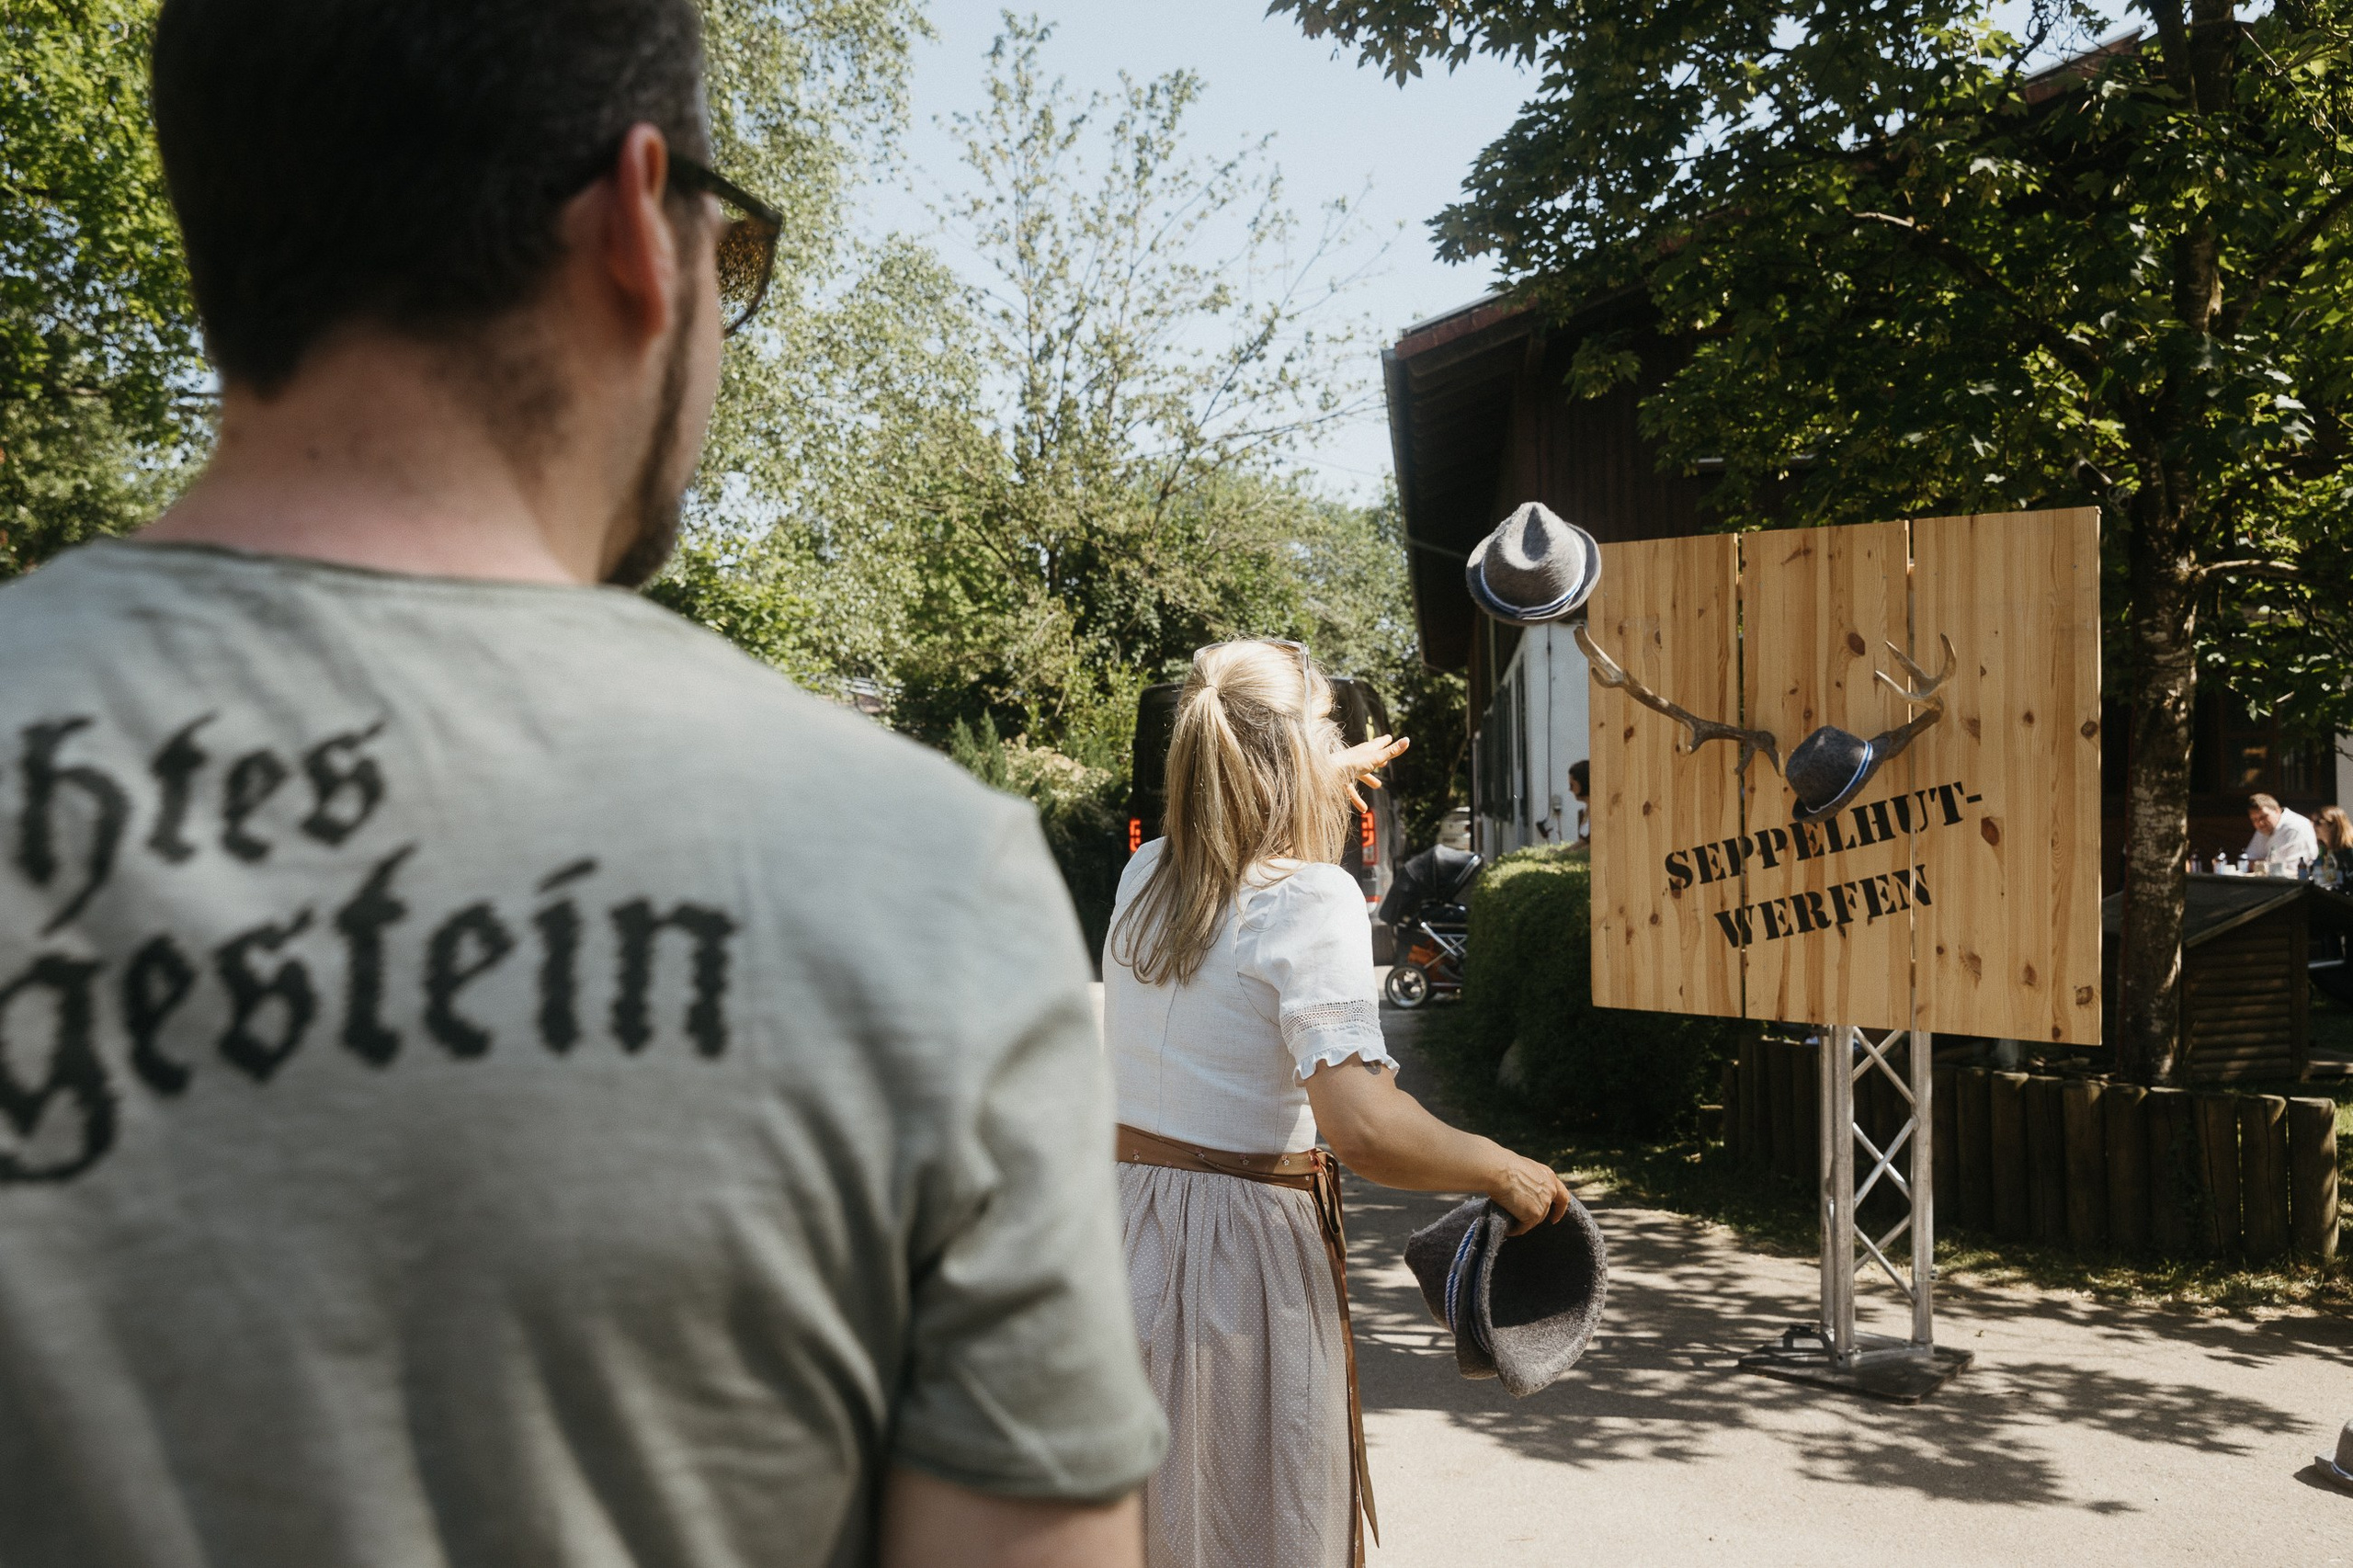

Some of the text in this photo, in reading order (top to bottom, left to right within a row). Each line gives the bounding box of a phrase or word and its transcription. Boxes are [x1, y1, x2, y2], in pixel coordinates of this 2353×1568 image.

[1665, 781, 1983, 891] SEPPELHUT-
[1714, 864, 1932, 949] WERFEN
[0, 842, 735, 1182] gestein
